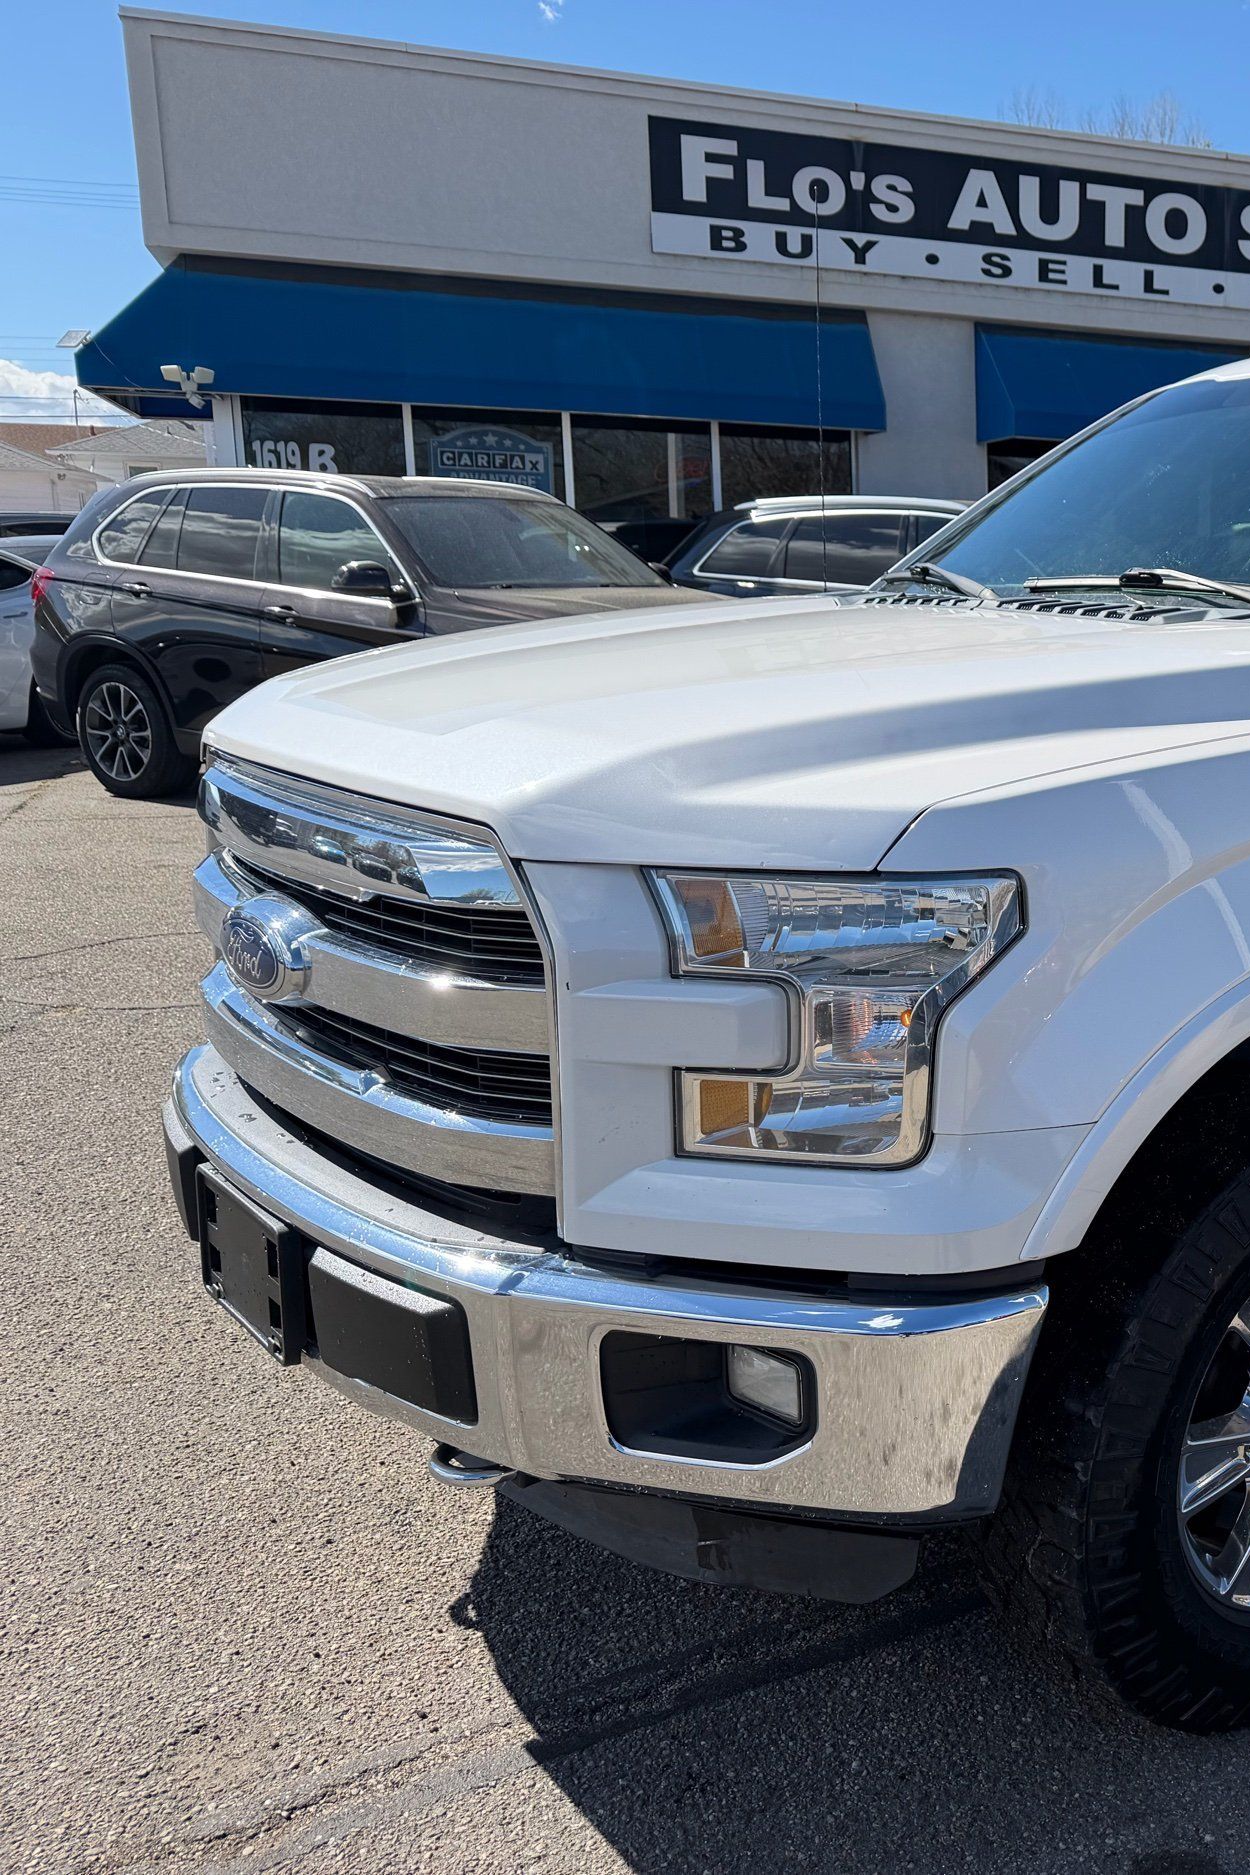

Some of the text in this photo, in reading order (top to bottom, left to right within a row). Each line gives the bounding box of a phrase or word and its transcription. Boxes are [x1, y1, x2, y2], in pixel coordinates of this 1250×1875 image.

[680, 133, 916, 224] FLO'S
[947, 168, 1208, 256] AUTO
[709, 223, 880, 266] BUY
[980, 252, 1170, 297] SELL
[251, 439, 339, 474] 1619 B
[440, 450, 542, 472] CARFAX
[228, 927, 262, 979] Ford
